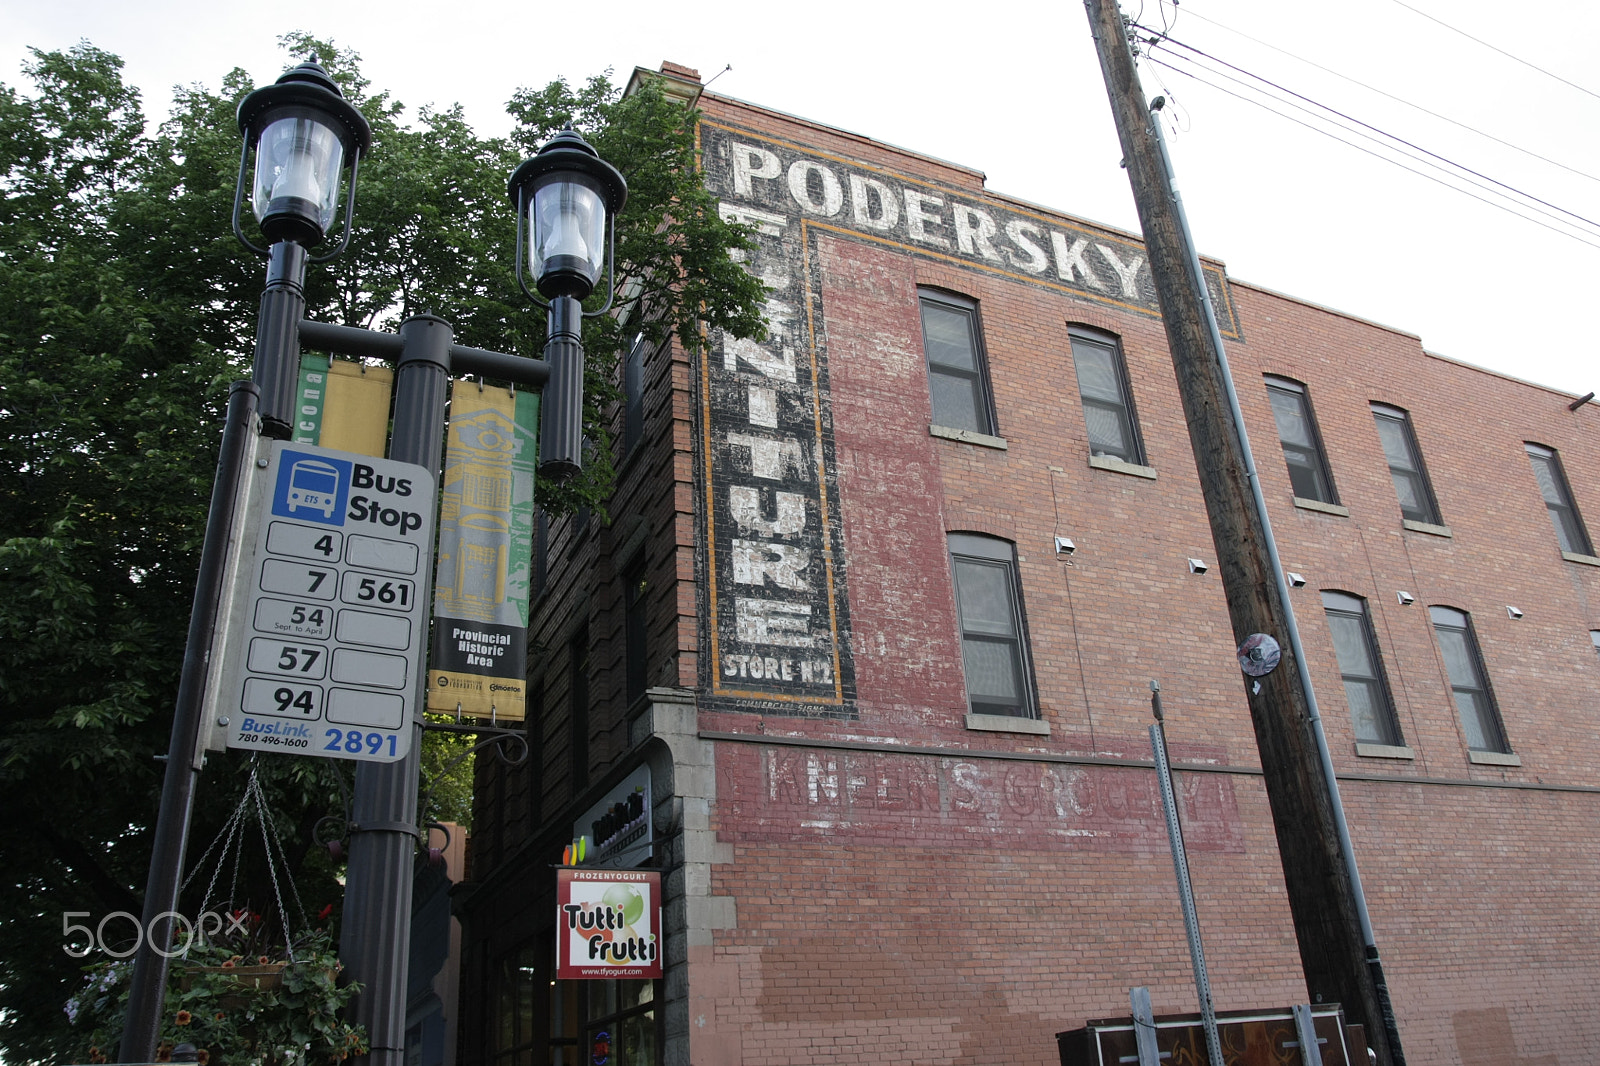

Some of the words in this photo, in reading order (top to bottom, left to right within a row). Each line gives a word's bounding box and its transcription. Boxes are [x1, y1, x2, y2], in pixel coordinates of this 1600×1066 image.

[732, 141, 1146, 300] PODERSKY
[351, 463, 413, 497] Bus
[304, 494, 319, 505] ETS
[347, 495, 423, 536] Stop
[313, 535, 334, 556] 4
[307, 570, 328, 593] 7
[357, 578, 409, 606] 561
[290, 605, 324, 627] 54
[295, 625, 303, 633] to
[305, 626, 323, 635] April
[453, 628, 511, 645] Provincial
[278, 646, 321, 672] 57
[459, 641, 504, 656] Historic
[466, 654, 493, 667] Area
[724, 653, 793, 681] STORE
[489, 684, 521, 692] Edmonton
[274, 687, 314, 714] 94
[238, 733, 258, 743] 780
[261, 735, 308, 748] 496-1600
[323, 728, 397, 757] 2891
[1004, 764, 1201, 821] GROCEY
[574, 872, 647, 880] FROZENYOGURT
[564, 904, 624, 930] Tutti
[581, 967, 643, 977] www.tfyogurt.com
